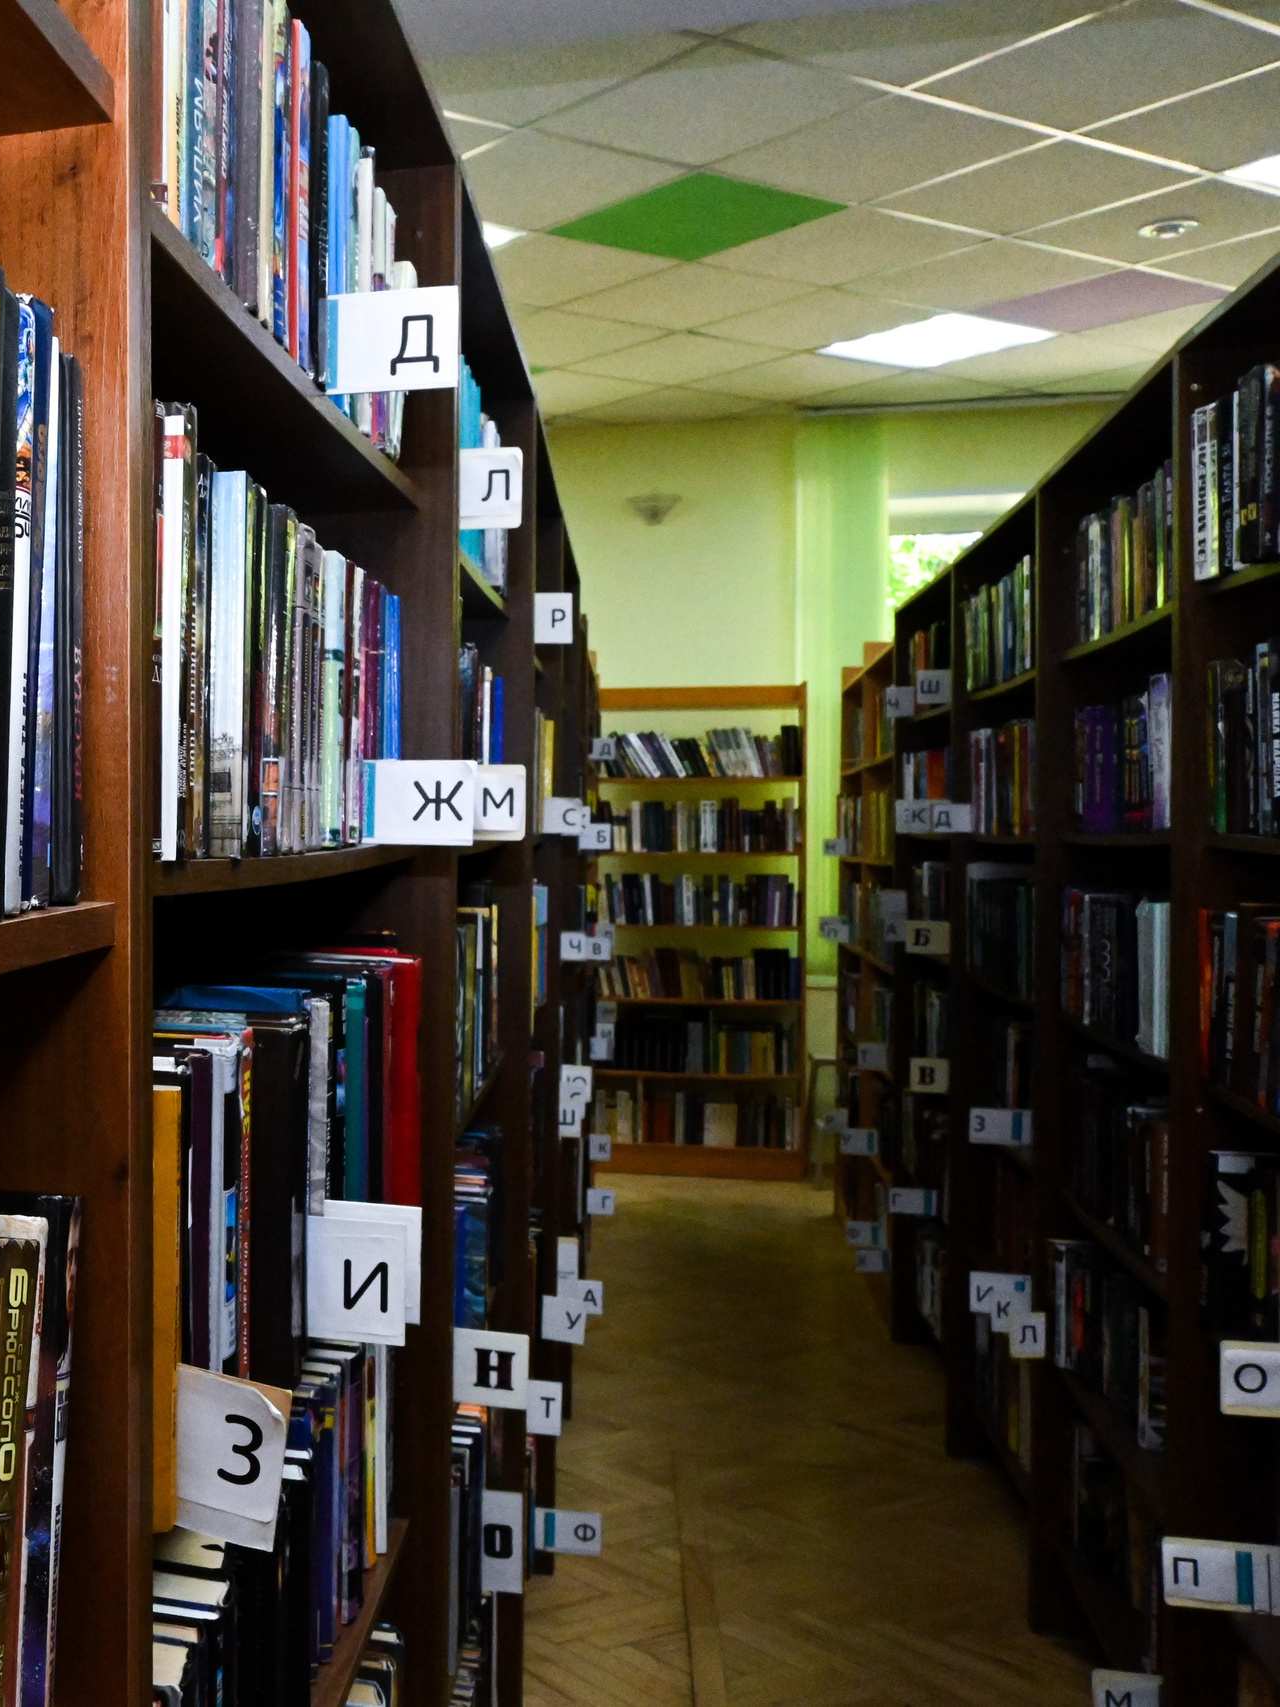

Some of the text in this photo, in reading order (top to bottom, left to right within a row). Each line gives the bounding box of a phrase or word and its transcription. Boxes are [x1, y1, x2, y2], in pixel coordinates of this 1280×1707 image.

[193, 78, 205, 224] УИЛЬЯМ
[390, 315, 440, 376] Д
[482, 469, 511, 502] Л
[551, 609, 567, 629] Р
[73, 646, 84, 800] КРАСНАЯ
[413, 780, 464, 822] Ж
[483, 787, 515, 818] М
[562, 806, 577, 825] С
[935, 810, 951, 828] Д
[918, 1066, 935, 1086] В
[242, 1070, 252, 1135] ЗАН
[974, 1115, 986, 1132] З
[344, 1259, 389, 1314] И
[584, 1289, 598, 1307] А
[565, 1311, 582, 1330] У
[1019, 1324, 1037, 1344] Л
[473, 1347, 516, 1391] Н
[1234, 1363, 1268, 1394] О
[540, 1397, 556, 1419] Т
[217, 1414, 263, 1485] З
[1173, 1556, 1199, 1587] П
